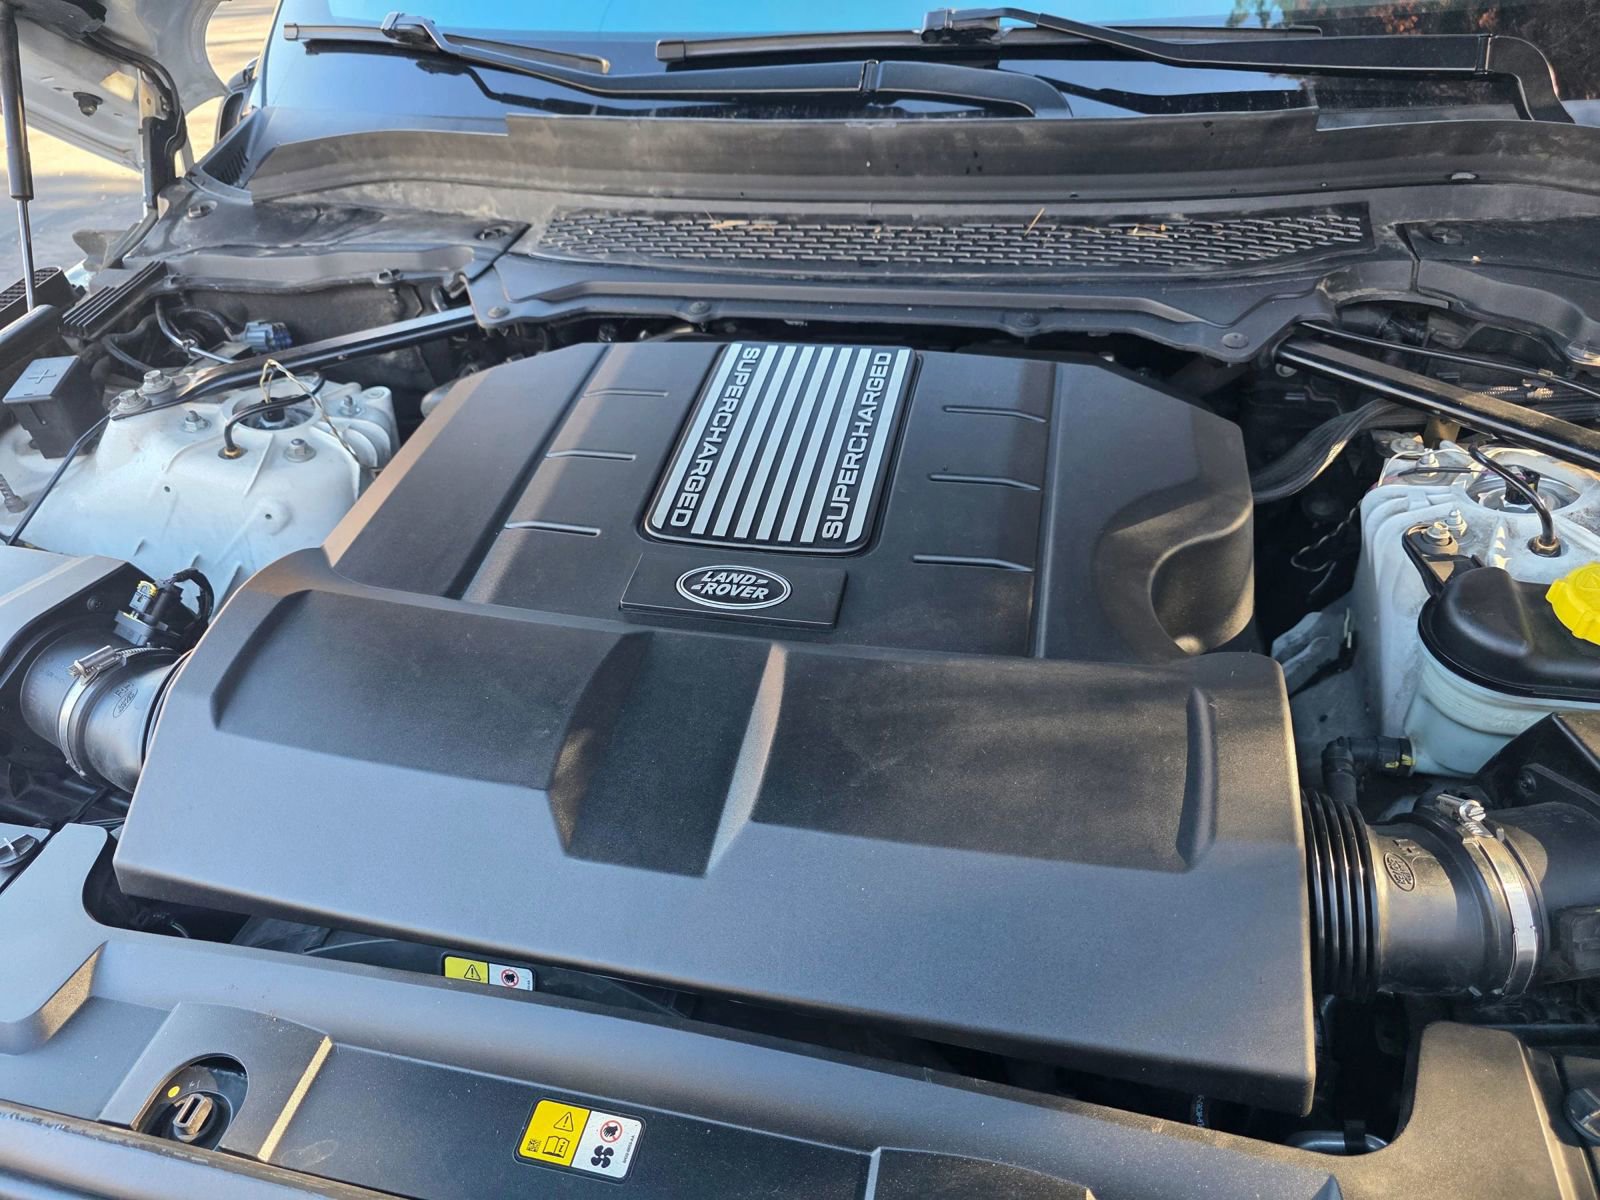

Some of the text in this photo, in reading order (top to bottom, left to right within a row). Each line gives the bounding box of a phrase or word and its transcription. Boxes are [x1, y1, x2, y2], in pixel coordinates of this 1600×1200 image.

[670, 346, 761, 528] SUPERCHARGED
[822, 351, 892, 539] SUPERCHARGED
[700, 582, 770, 600] ROVER
[701, 570, 757, 586] LAND
